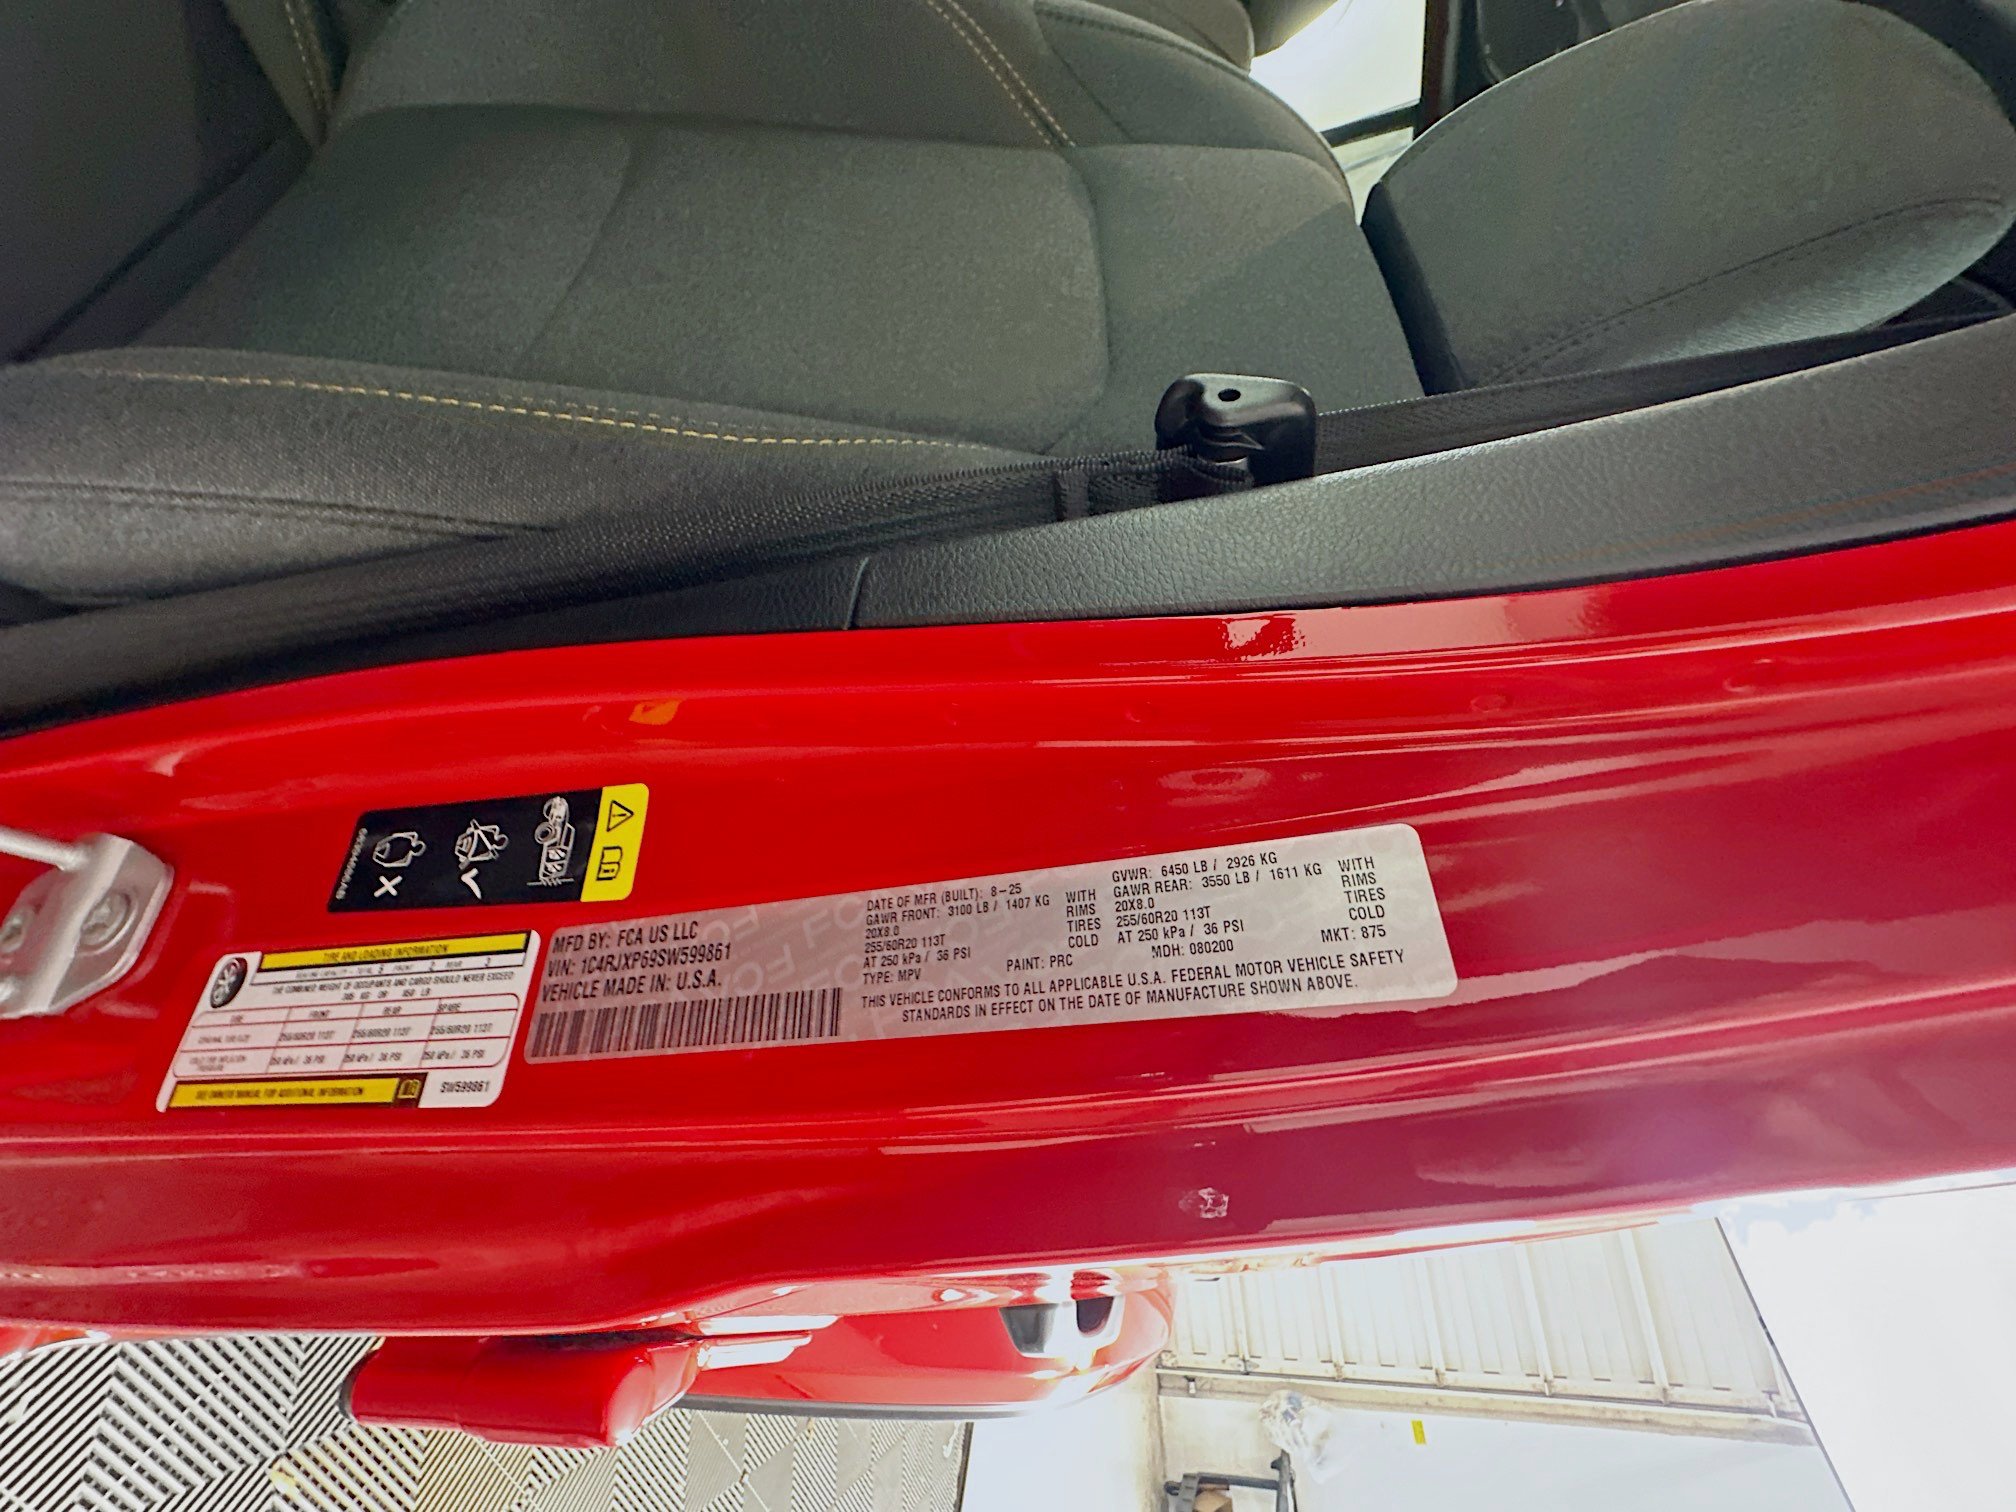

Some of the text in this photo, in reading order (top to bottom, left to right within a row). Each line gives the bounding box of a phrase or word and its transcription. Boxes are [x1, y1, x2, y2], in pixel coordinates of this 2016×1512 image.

[1112, 867, 1152, 883] GVWR:
[1161, 863, 1189, 877] 6450
[1194, 860, 1208, 873] LB
[1226, 855, 1255, 869] 2926
[1259, 852, 1277, 866] KG
[1338, 856, 1375, 873] WITH
[1114, 882, 1150, 898] GAWR
[1155, 878, 1192, 894] REAR:
[1201, 874, 1230, 888] 3550
[1235, 871, 1250, 885] LB
[1270, 866, 1298, 880] 1611
[1304, 862, 1322, 877] KG
[1341, 871, 1377, 888] RIMS
[867, 898, 893, 912] DATE
[897, 895, 910, 908] OF
[914, 892, 937, 905] MFR
[941, 888, 983, 906] (BUILT):
[1066, 889, 1096, 903] WITH
[1115, 897, 1155, 912] 20X8.0
[1344, 887, 1386, 904] TIRES
[866, 911, 898, 926] GAWR
[901, 907, 941, 922] FRONT:
[948, 904, 973, 917] 3100
[976, 901, 989, 914] LB
[1006, 897, 1031, 911] 1407
[1034, 894, 1050, 907] KG
[1066, 903, 1096, 918] RIMS
[1116, 906, 1211, 928] 255/60R20 113T
[1348, 904, 1386, 921] COLD
[865, 925, 900, 940] 20X8.0
[1067, 918, 1101, 933] TIRES
[1117, 930, 1132, 944] AT
[1138, 928, 1159, 942] 250
[1163, 926, 1186, 940] kPa
[1203, 922, 1218, 935] 36
[1224, 919, 1245, 934] PSI
[1321, 925, 1386, 944] MKT: 875
[552, 935, 584, 953] MFD
[588, 932, 611, 950] BY:
[617, 928, 643, 947] FCA
[650, 924, 669, 944] US
[673, 921, 699, 940] LLC
[921, 934, 946, 948] 113T
[1068, 934, 1099, 949] COLD
[863, 956, 877, 969] AT
[881, 954, 899, 967] 250
[902, 952, 921, 965] kPa
[953, 946, 971, 960] PSI
[1151, 939, 1234, 959] MDH: 080200
[548, 959, 576, 978] VIN:
[1006, 953, 1073, 972] PAINT: PRC
[433, 974, 461, 984] SHOULD
[463, 972, 485, 982] NEVER
[487, 971, 514, 981] EXCEED
[542, 969, 722, 1002] VEHICLE MADE IN: U.S.A.
[861, 949, 1405, 1009] THIS VEHICLE CONFORMS TO ALL APPLICABLE U.S.A. FEDERAL MOTOR VEHICLE SAFETY
[862, 968, 922, 985] TYPE: MPV
[902, 973, 1359, 1023] STANDARDS IN EFFECT ON THE DATE OF MANUFACTURE SHOWN ABOVE.
[440, 1080, 490, 1093] SW599861
